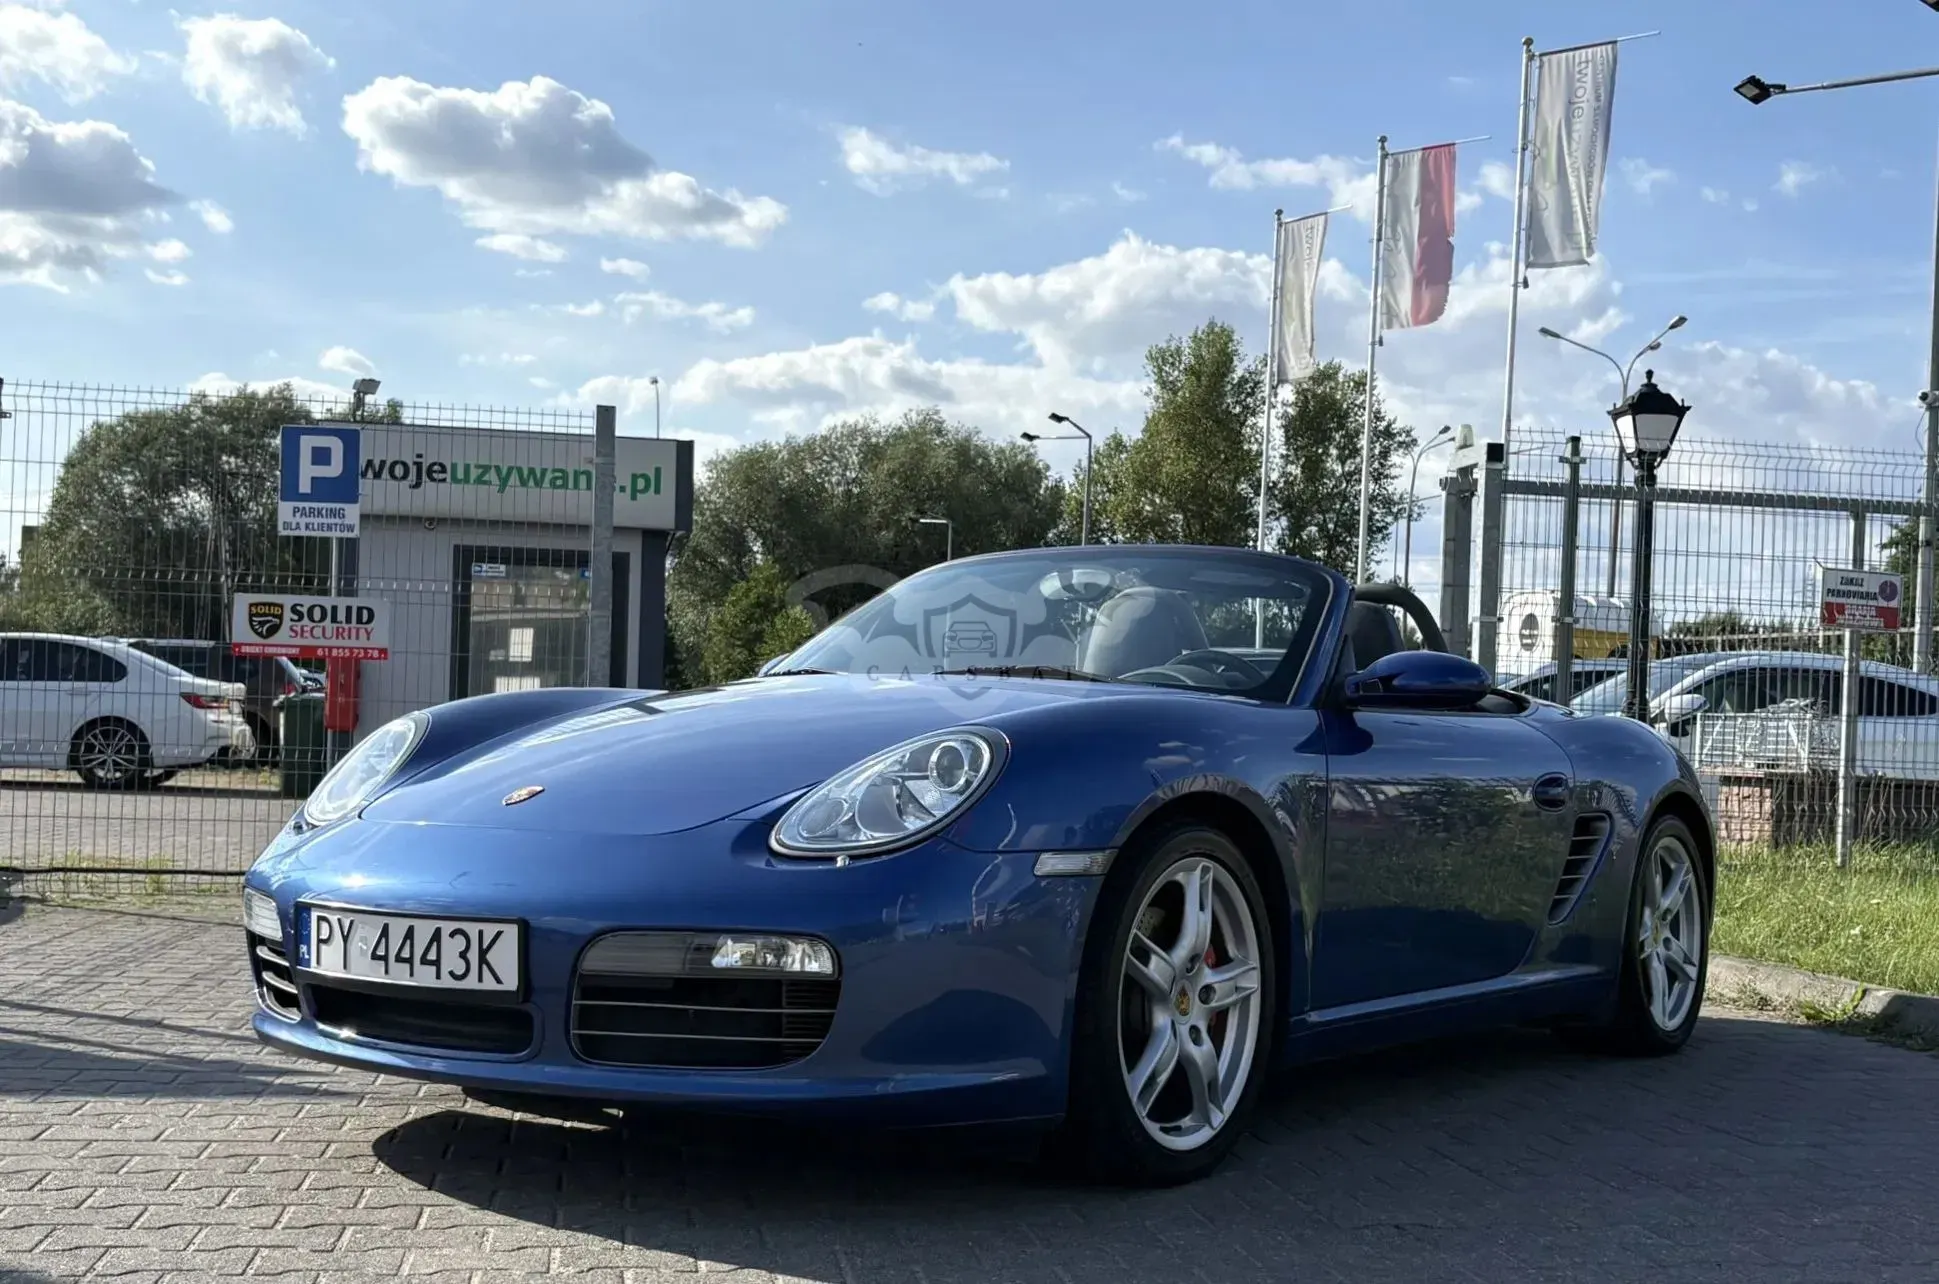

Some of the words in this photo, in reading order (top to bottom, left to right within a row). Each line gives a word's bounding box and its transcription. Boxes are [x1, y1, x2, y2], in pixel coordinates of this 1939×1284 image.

[299, 434, 344, 494] P
[292, 506, 346, 520] PARKING
[282, 521, 301, 532] DLA
[250, 605, 282, 615] SOLID
[289, 603, 376, 626] SOLID
[289, 624, 374, 641] SECURITY
[316, 647, 329, 657] 61
[331, 647, 350, 659] 855
[352, 648, 364, 658] 73
[367, 649, 379, 659] 78
[315, 914, 355, 971] PY
[370, 922, 505, 986] 4443K
